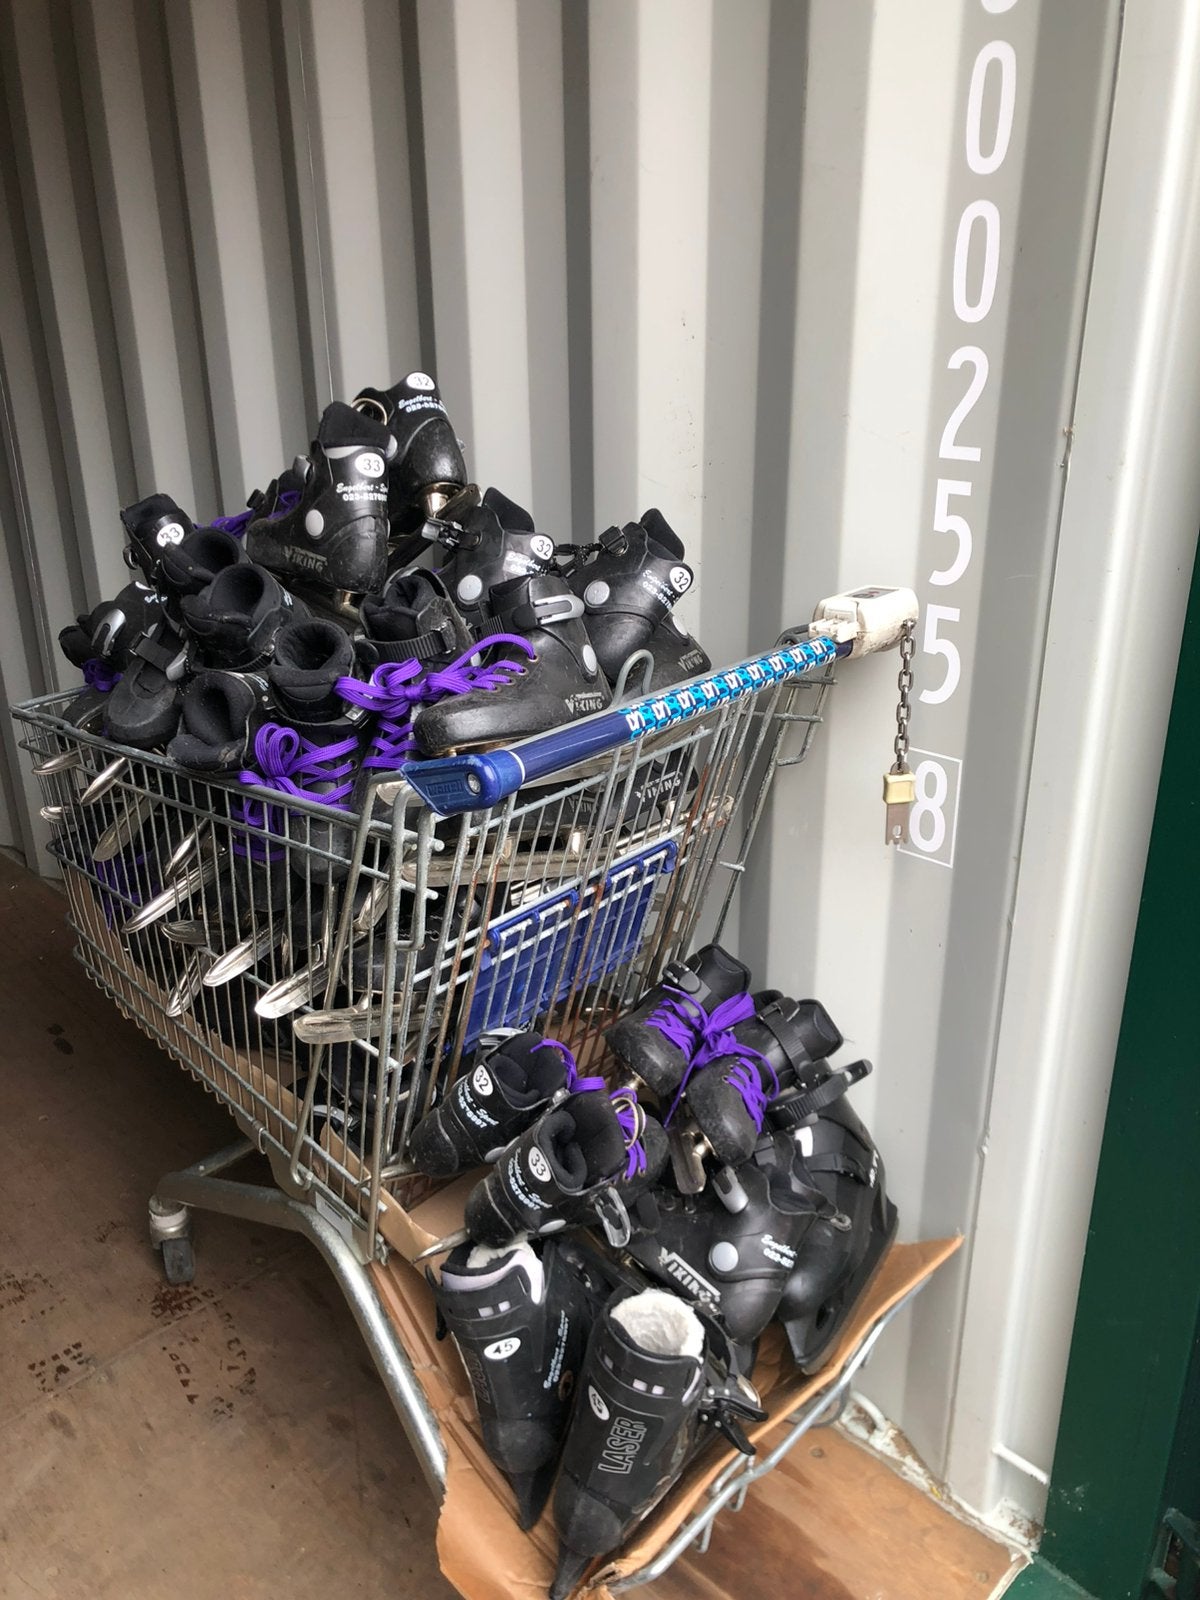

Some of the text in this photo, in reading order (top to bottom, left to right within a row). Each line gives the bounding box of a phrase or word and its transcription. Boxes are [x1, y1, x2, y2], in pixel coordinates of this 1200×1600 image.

[363, 458, 381, 473] 33
[160, 528, 180, 543] 33
[535, 539, 552, 557] 32
[284, 546, 328, 573] VIKING
[674, 570, 690, 589] 32
[678, 653, 703, 672] VIKING
[565, 693, 603, 714] VIKING
[907, 760, 949, 854] 8
[474, 1069, 490, 1092] 32
[530, 1154, 547, 1177] 33
[597, 1417, 648, 1475] LASER
